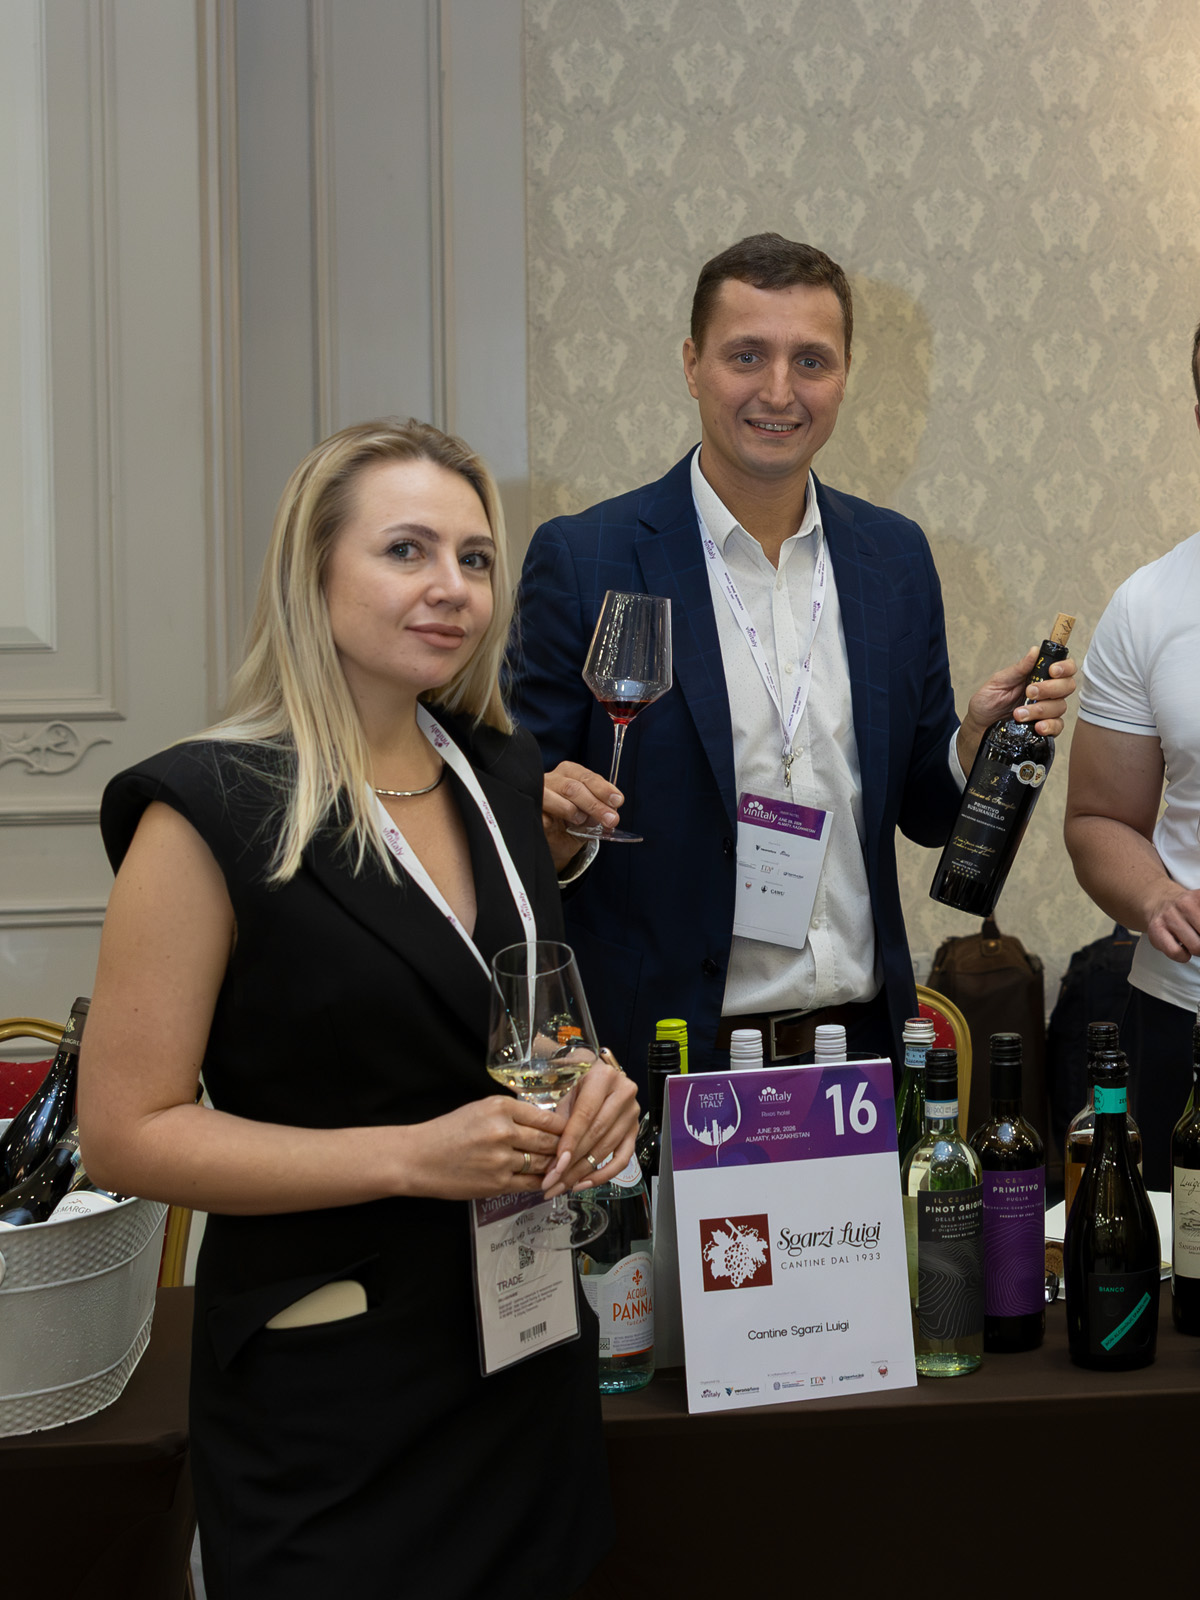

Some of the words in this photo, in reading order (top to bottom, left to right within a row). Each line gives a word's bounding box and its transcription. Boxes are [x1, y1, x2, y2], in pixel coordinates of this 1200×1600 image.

[704, 539, 716, 560] vinitaly
[746, 626, 757, 648] vinitaly
[430, 723, 451, 748] vinitaly
[743, 806, 778, 823] vinitaly
[974, 801, 1000, 815] PRIMITIVO
[382, 827, 404, 856] vinitaly
[519, 891, 532, 921] vinitaly
[698, 1092, 724, 1100] TASTE
[758, 1092, 792, 1103] vinitaly
[825, 1081, 878, 1136] 16
[745, 1135, 770, 1143] ALMATY,
[771, 1132, 810, 1141] KAZAKHSTAN
[992, 1184, 1039, 1193] PRIMITIVO
[1180, 1174, 1200, 1196] Luigi
[481, 1192, 518, 1213] vinitaly
[777, 1226, 834, 1257] Sgarzi
[837, 1221, 881, 1249] Luigi
[781, 1258, 826, 1270] CANTINE
[831, 1256, 849, 1265] DAL
[856, 1252, 881, 1262] 1933
[497, 1273, 524, 1292] TRADE
[626, 1287, 647, 1301] ACQUA
[612, 1296, 653, 1322] PANNA
[748, 1328, 788, 1340] Cantine
[791, 1323, 823, 1337] Sgarzi
[826, 1320, 850, 1332] Luigi
[700, 1390, 720, 1398] vinitaly
